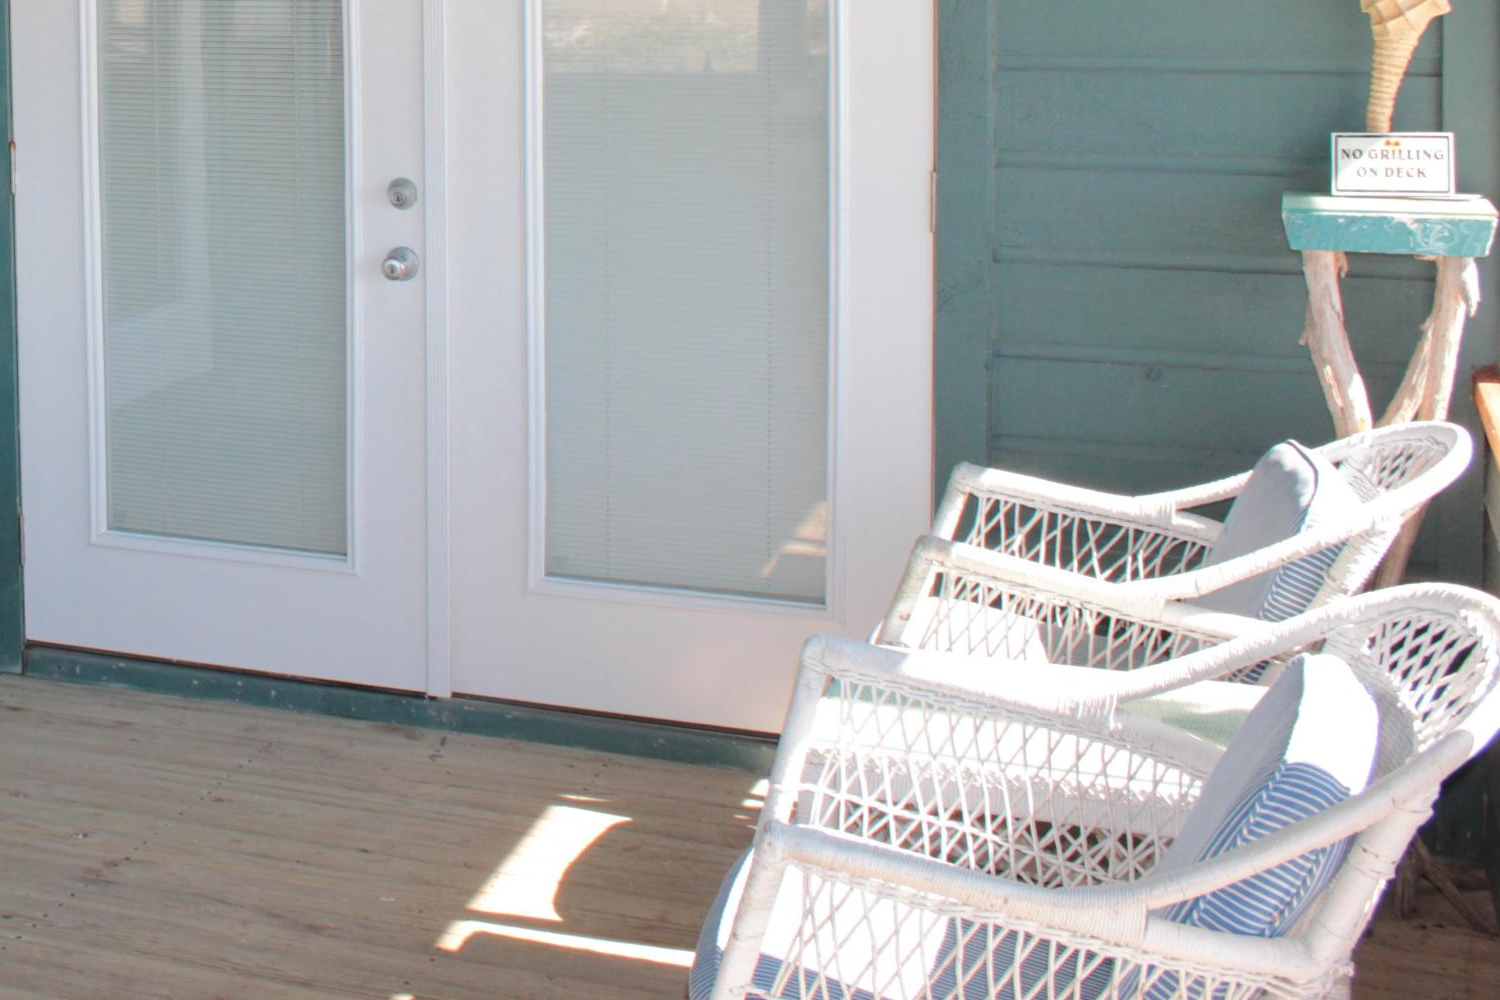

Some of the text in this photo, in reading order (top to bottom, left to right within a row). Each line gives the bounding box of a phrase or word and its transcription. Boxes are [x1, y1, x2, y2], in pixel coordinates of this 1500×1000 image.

[1341, 148, 1444, 161] NO GRILLING
[1356, 167, 1428, 179] ON DECK
